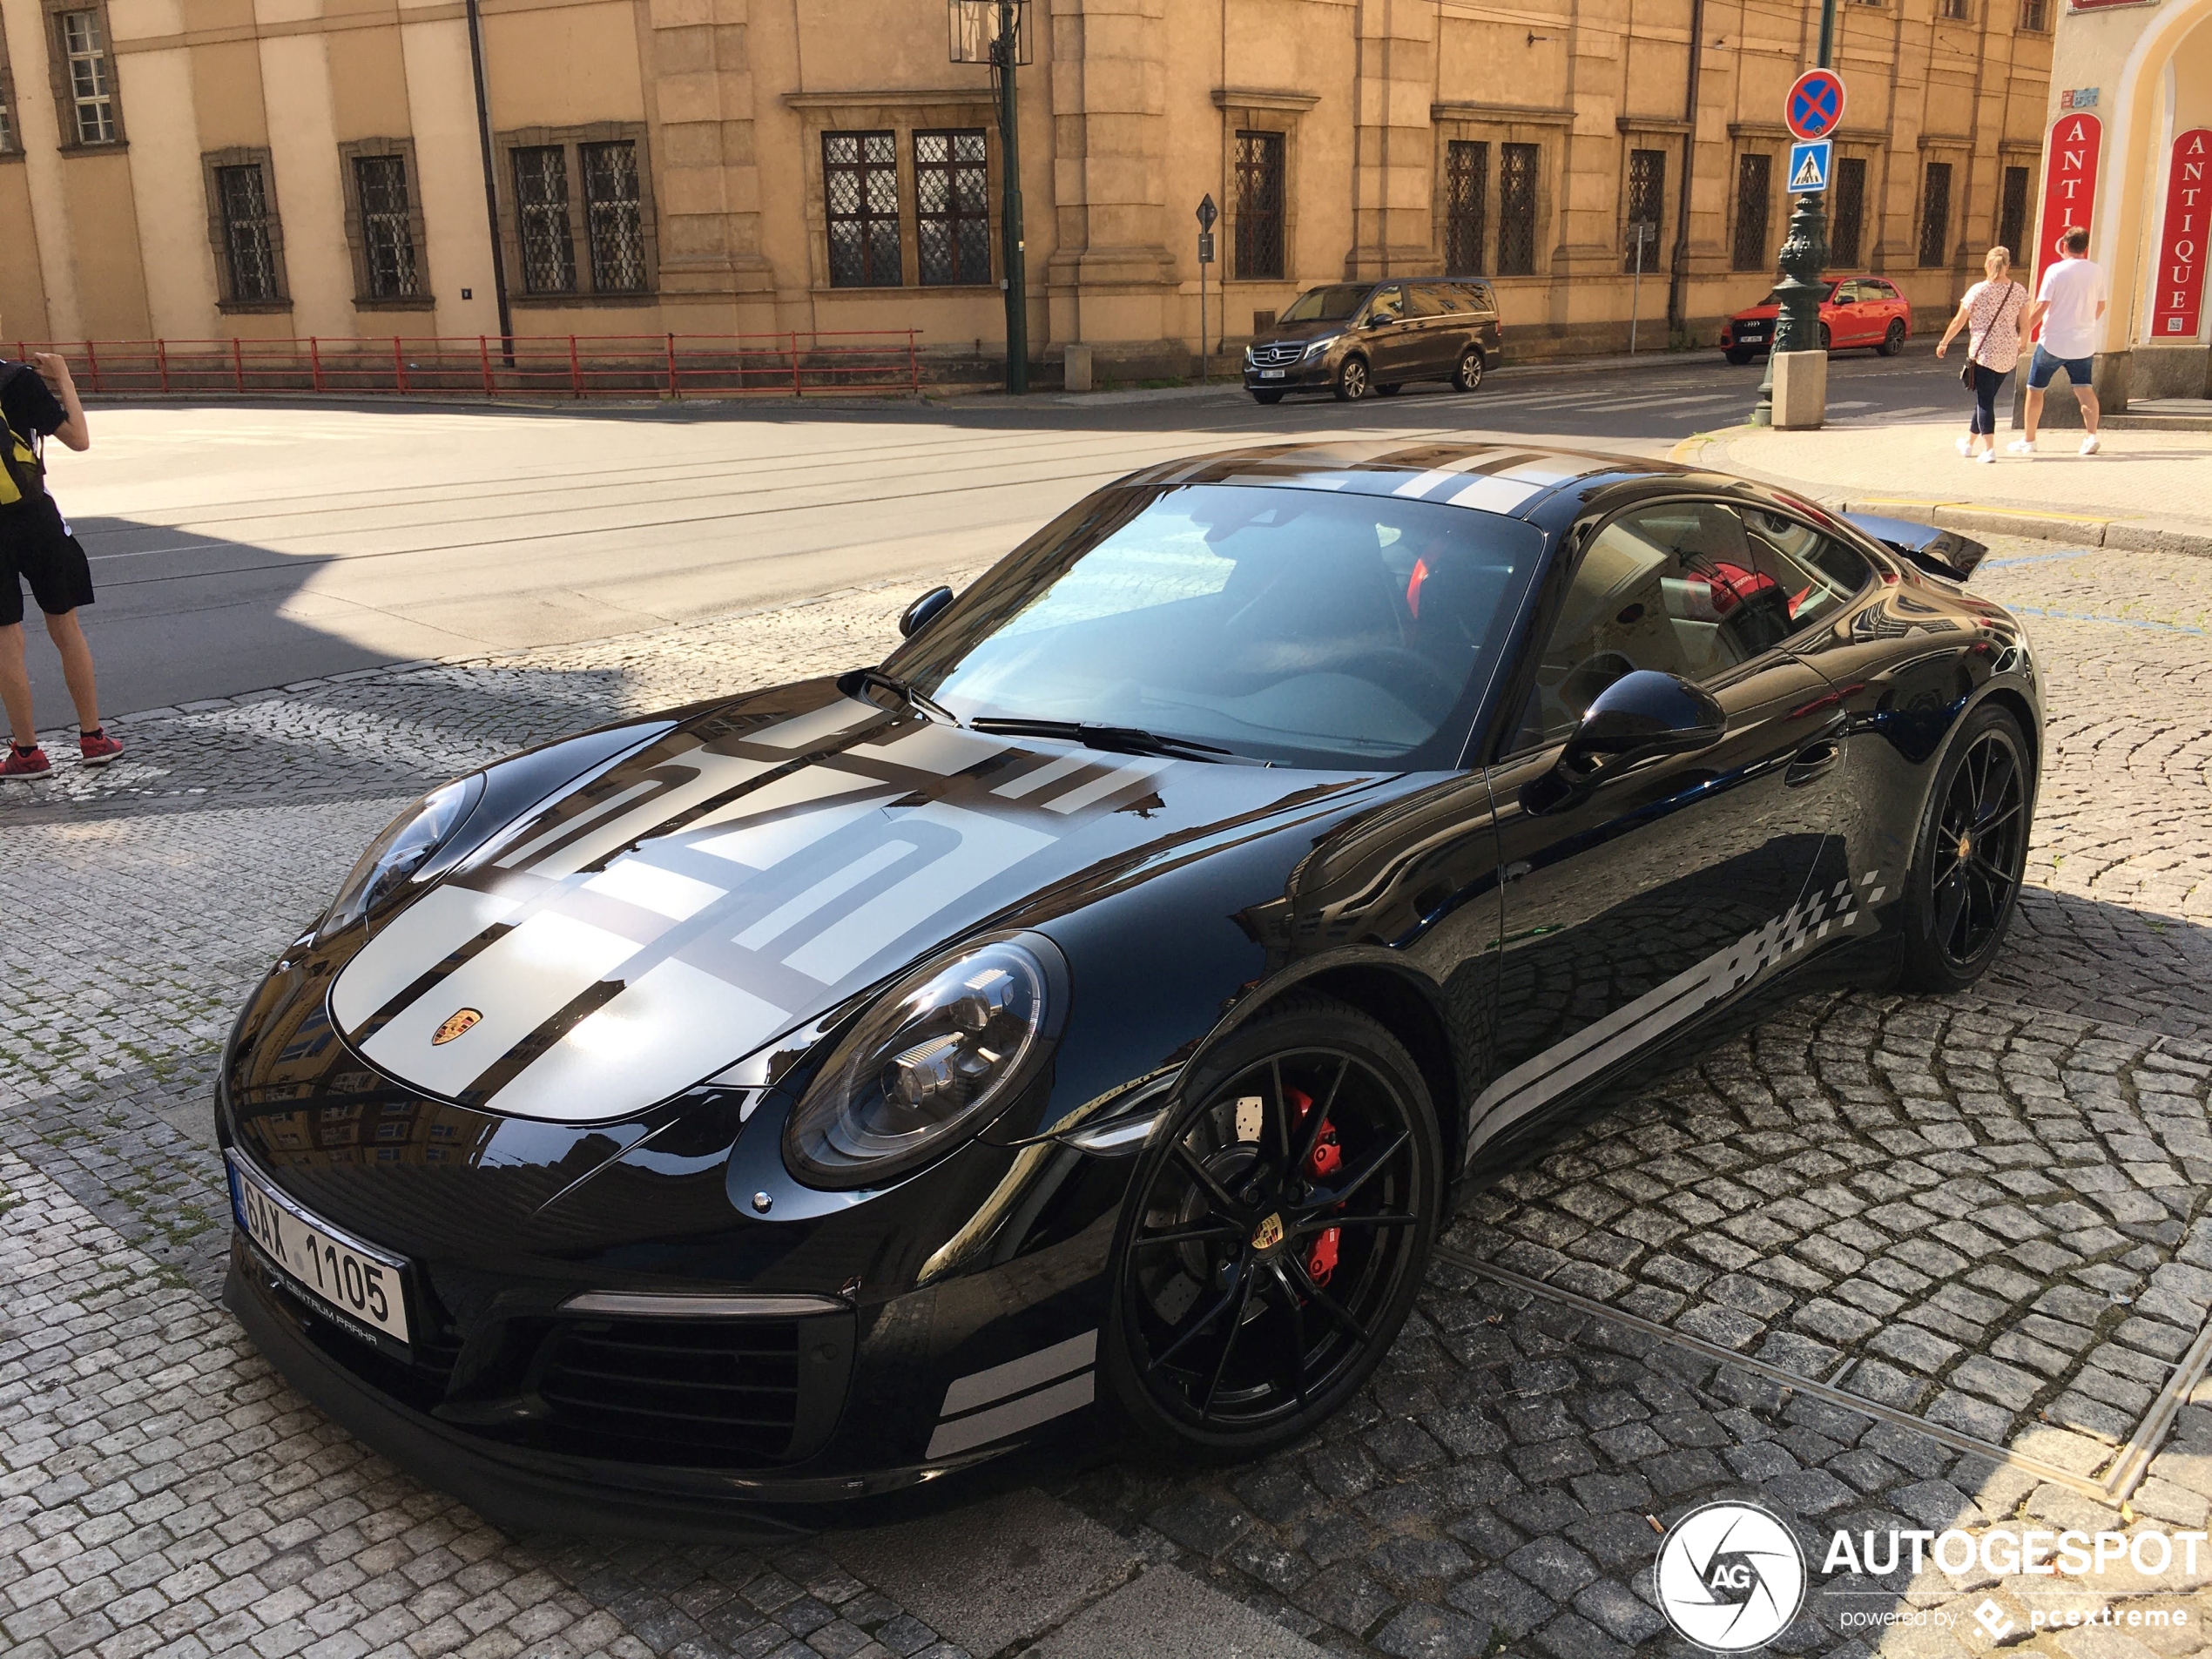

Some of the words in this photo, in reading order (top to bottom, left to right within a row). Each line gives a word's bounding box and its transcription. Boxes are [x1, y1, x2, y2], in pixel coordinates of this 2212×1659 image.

[2054, 120, 2086, 260] ANTI
[2170, 135, 2205, 308] ANTIQUE
[244, 1181, 287, 1264] 6AX
[306, 1233, 389, 1322] 1105
[287, 1281, 334, 1320] CENTRUM
[336, 1314, 377, 1345] PRAHA
